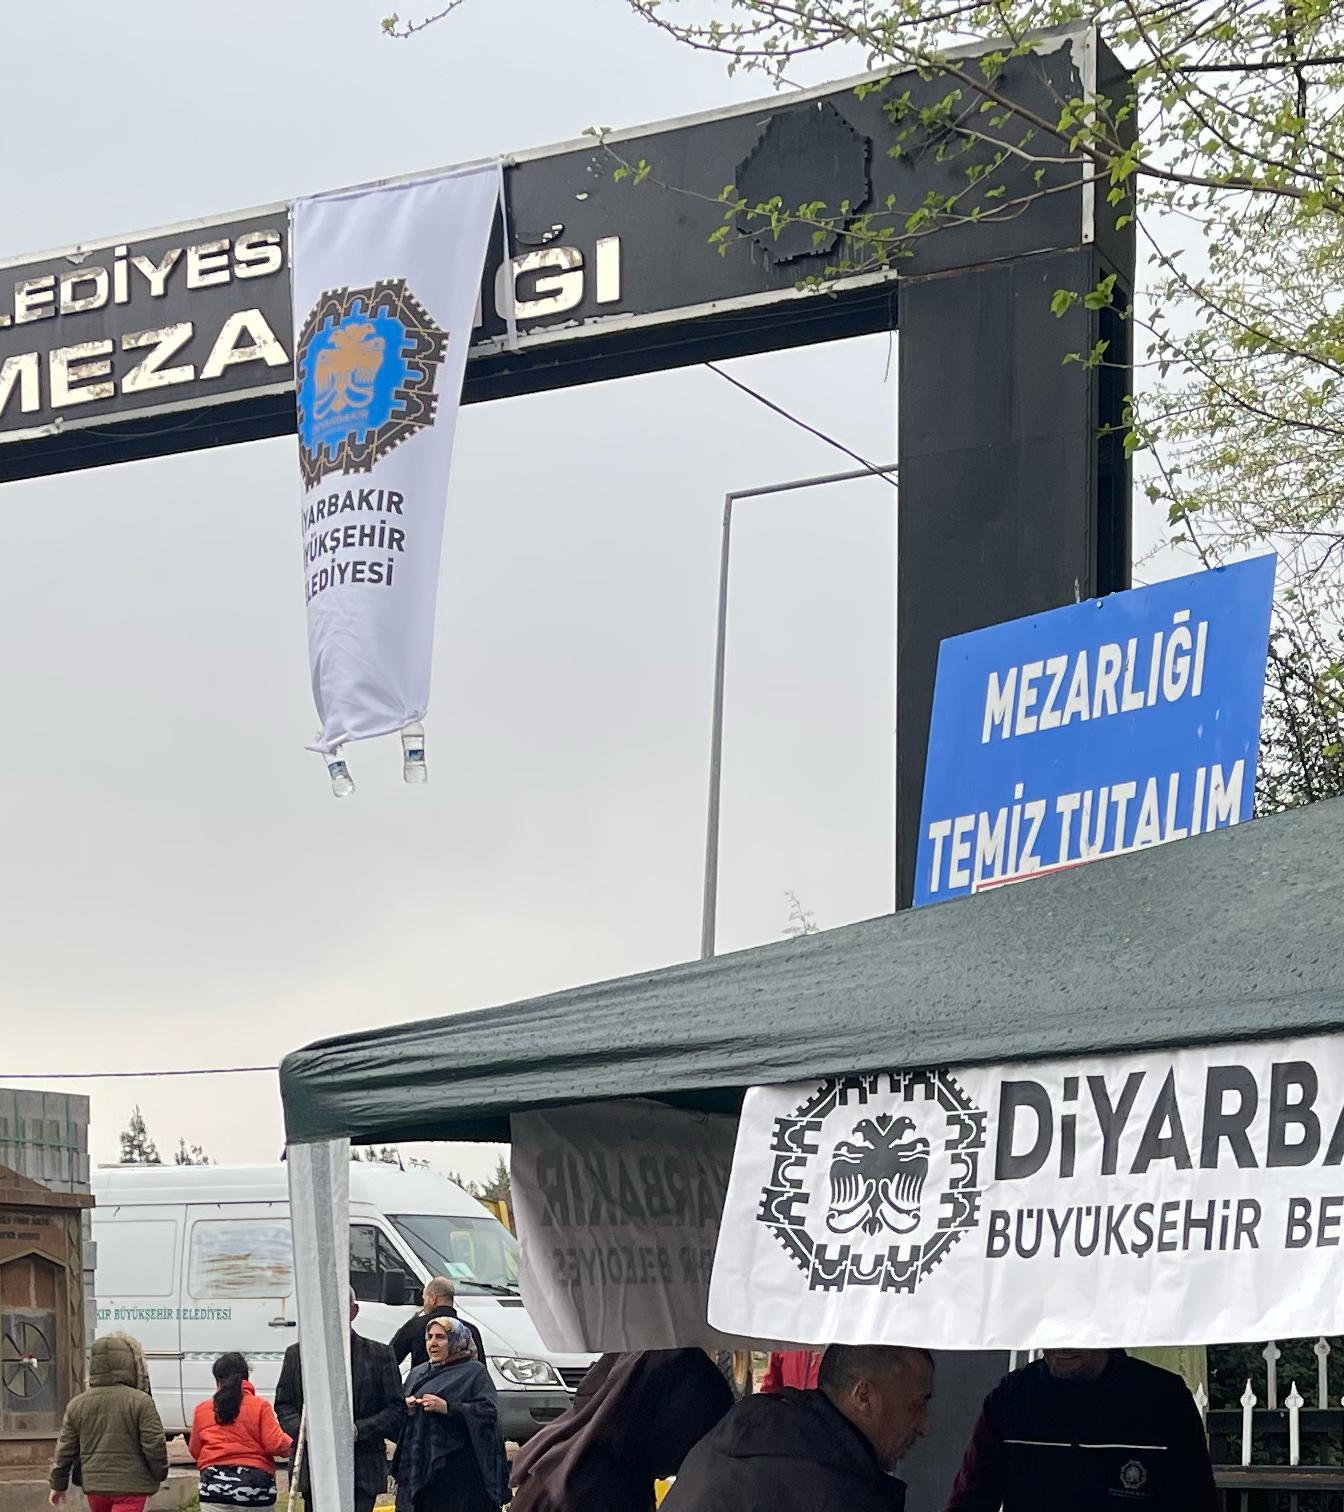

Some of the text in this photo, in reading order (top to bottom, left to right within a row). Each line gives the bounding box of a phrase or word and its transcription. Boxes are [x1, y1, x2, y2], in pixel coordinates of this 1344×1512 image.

[981, 609, 1209, 744] MEZARLIĞI
[928, 759, 1245, 893] TEMİZ TUTALIM
